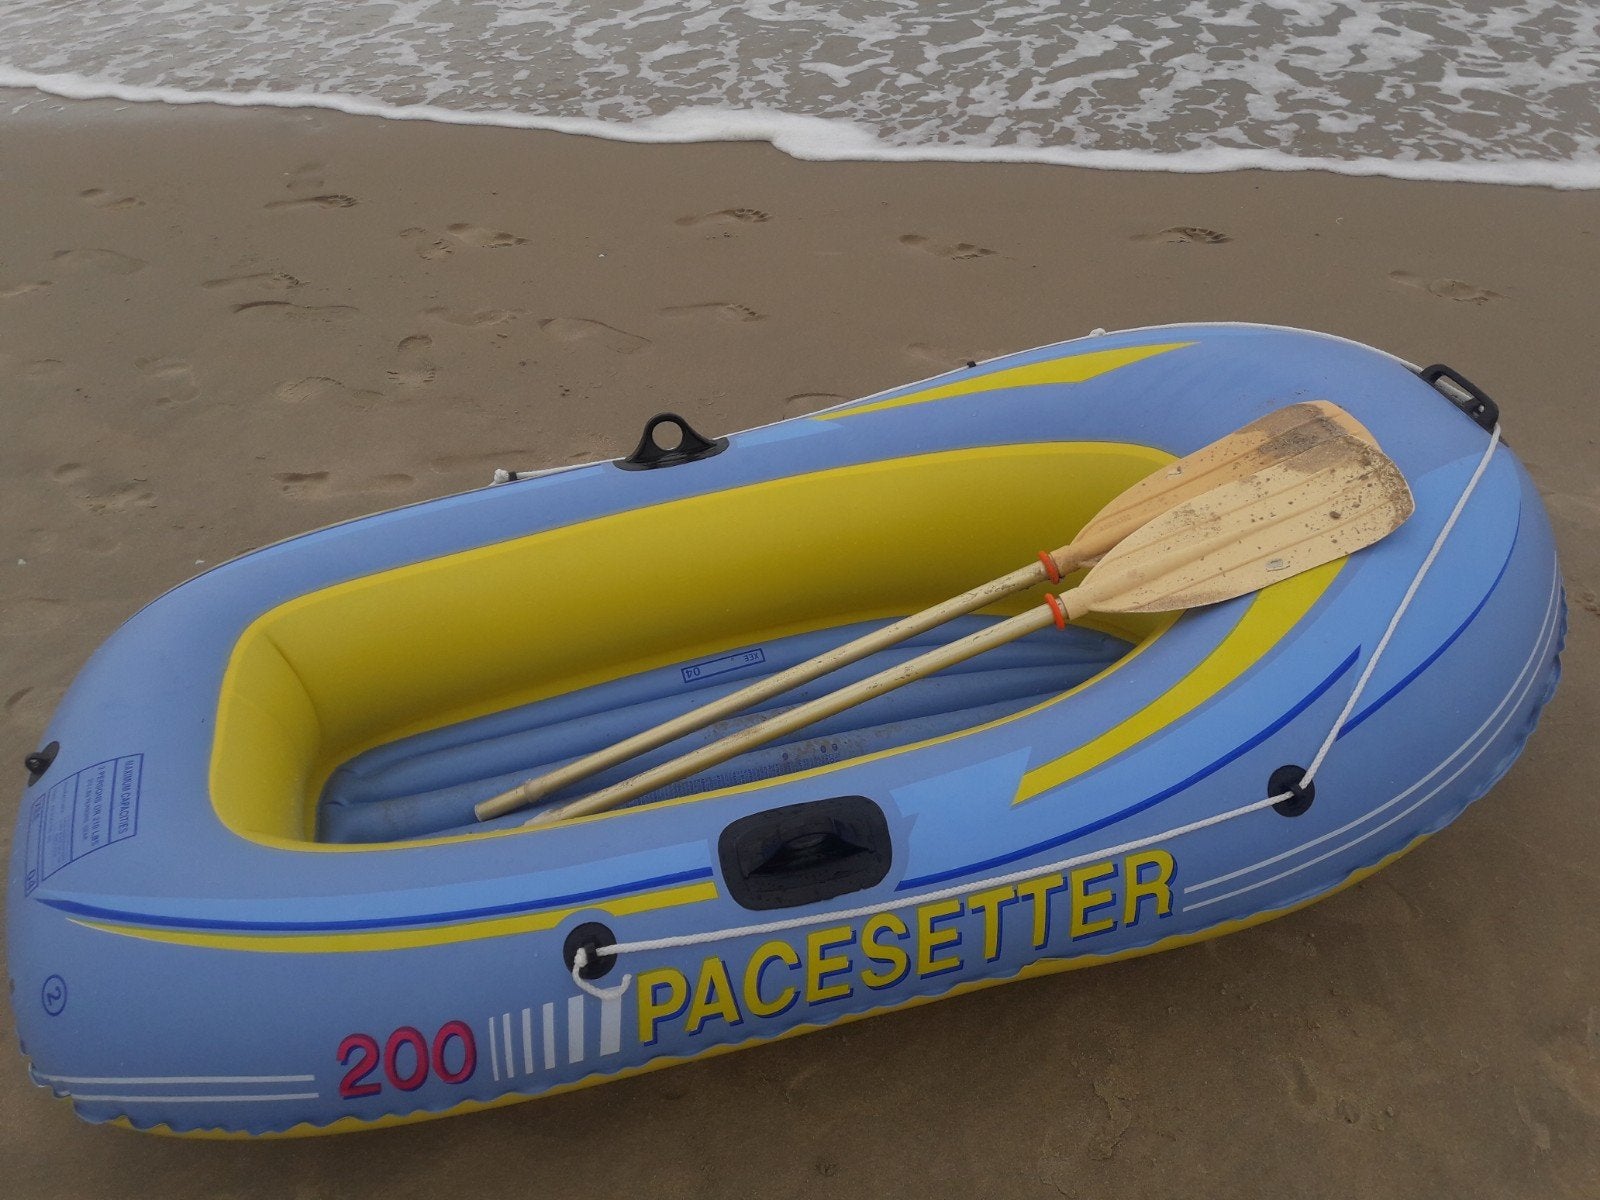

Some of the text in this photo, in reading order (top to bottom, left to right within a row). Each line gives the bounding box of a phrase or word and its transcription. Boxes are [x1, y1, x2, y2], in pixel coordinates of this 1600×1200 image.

[686, 667, 701, 679] 04
[119, 792, 131, 835] CAPACITIES
[636, 849, 1178, 1046] PACESETTER
[47, 985, 61, 1006] 2
[336, 1020, 478, 1099] 200
